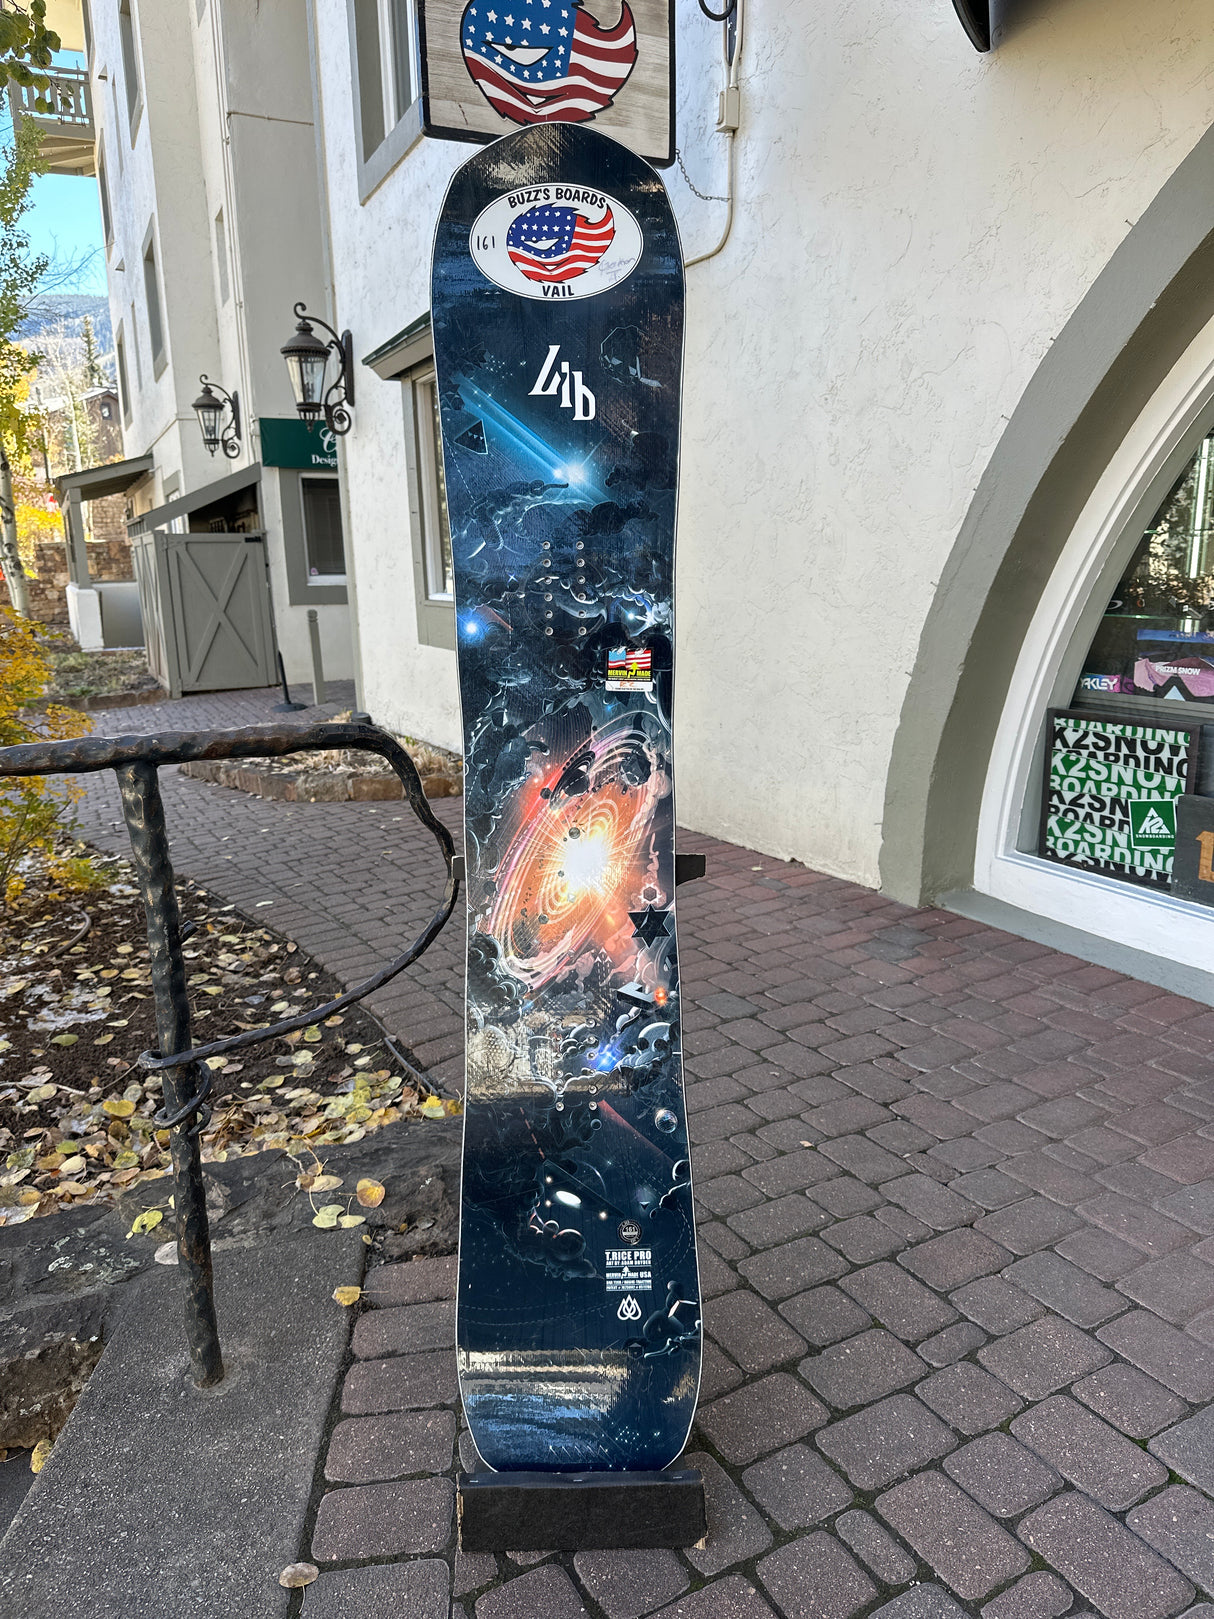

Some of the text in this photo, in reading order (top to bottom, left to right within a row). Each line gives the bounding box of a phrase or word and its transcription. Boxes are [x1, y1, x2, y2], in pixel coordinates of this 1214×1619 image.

[507, 187, 607, 209] BUZZ'S BOARDS
[476, 235, 496, 251] 161
[542, 285, 575, 297] VAIL
[1155, 665, 1201, 676] PRIZM SNOW
[1081, 677, 1119, 691] AKLEY
[605, 1250, 651, 1260] T.RICE PRO
